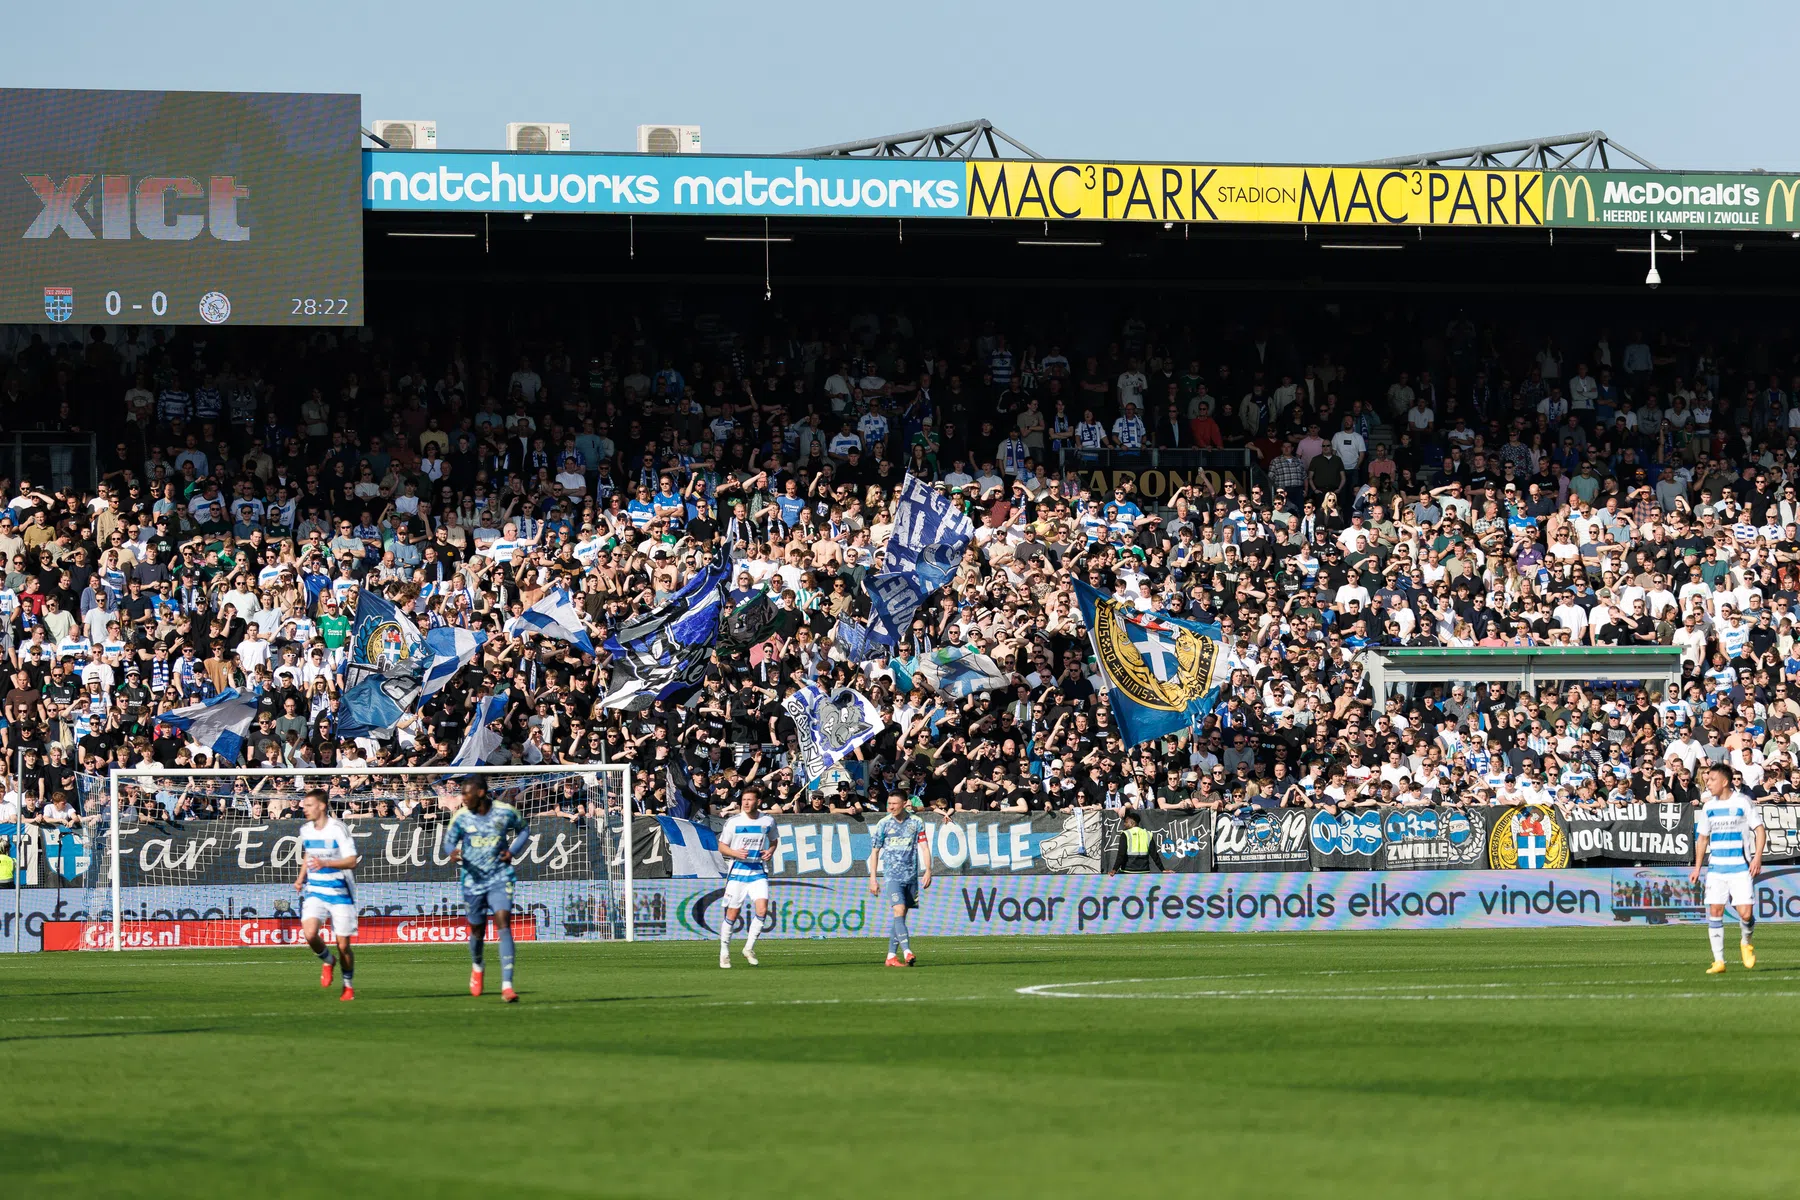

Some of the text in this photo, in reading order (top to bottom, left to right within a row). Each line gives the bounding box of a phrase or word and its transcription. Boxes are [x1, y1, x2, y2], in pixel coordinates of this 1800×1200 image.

[367, 161, 960, 209] matchworks matchworks
[1218, 185, 1297, 204] STADION
[1603, 181, 1761, 206] McDonald's
[1603, 210, 1648, 223] HEERDE
[1656, 210, 1705, 224] KAMPEN
[1714, 211, 1760, 225] ZWOLLE
[105, 290, 121, 316] 0
[151, 291, 168, 316] 0
[291, 298, 349, 316] 28:22
[1310, 809, 1383, 856] 038
[1569, 828, 1689, 855] VOOR ULTRAS
[773, 823, 853, 875] FEU
[1387, 842, 1448, 861] ZWOLLE
[961, 881, 1601, 931] Waar professionals elkaar vinden
